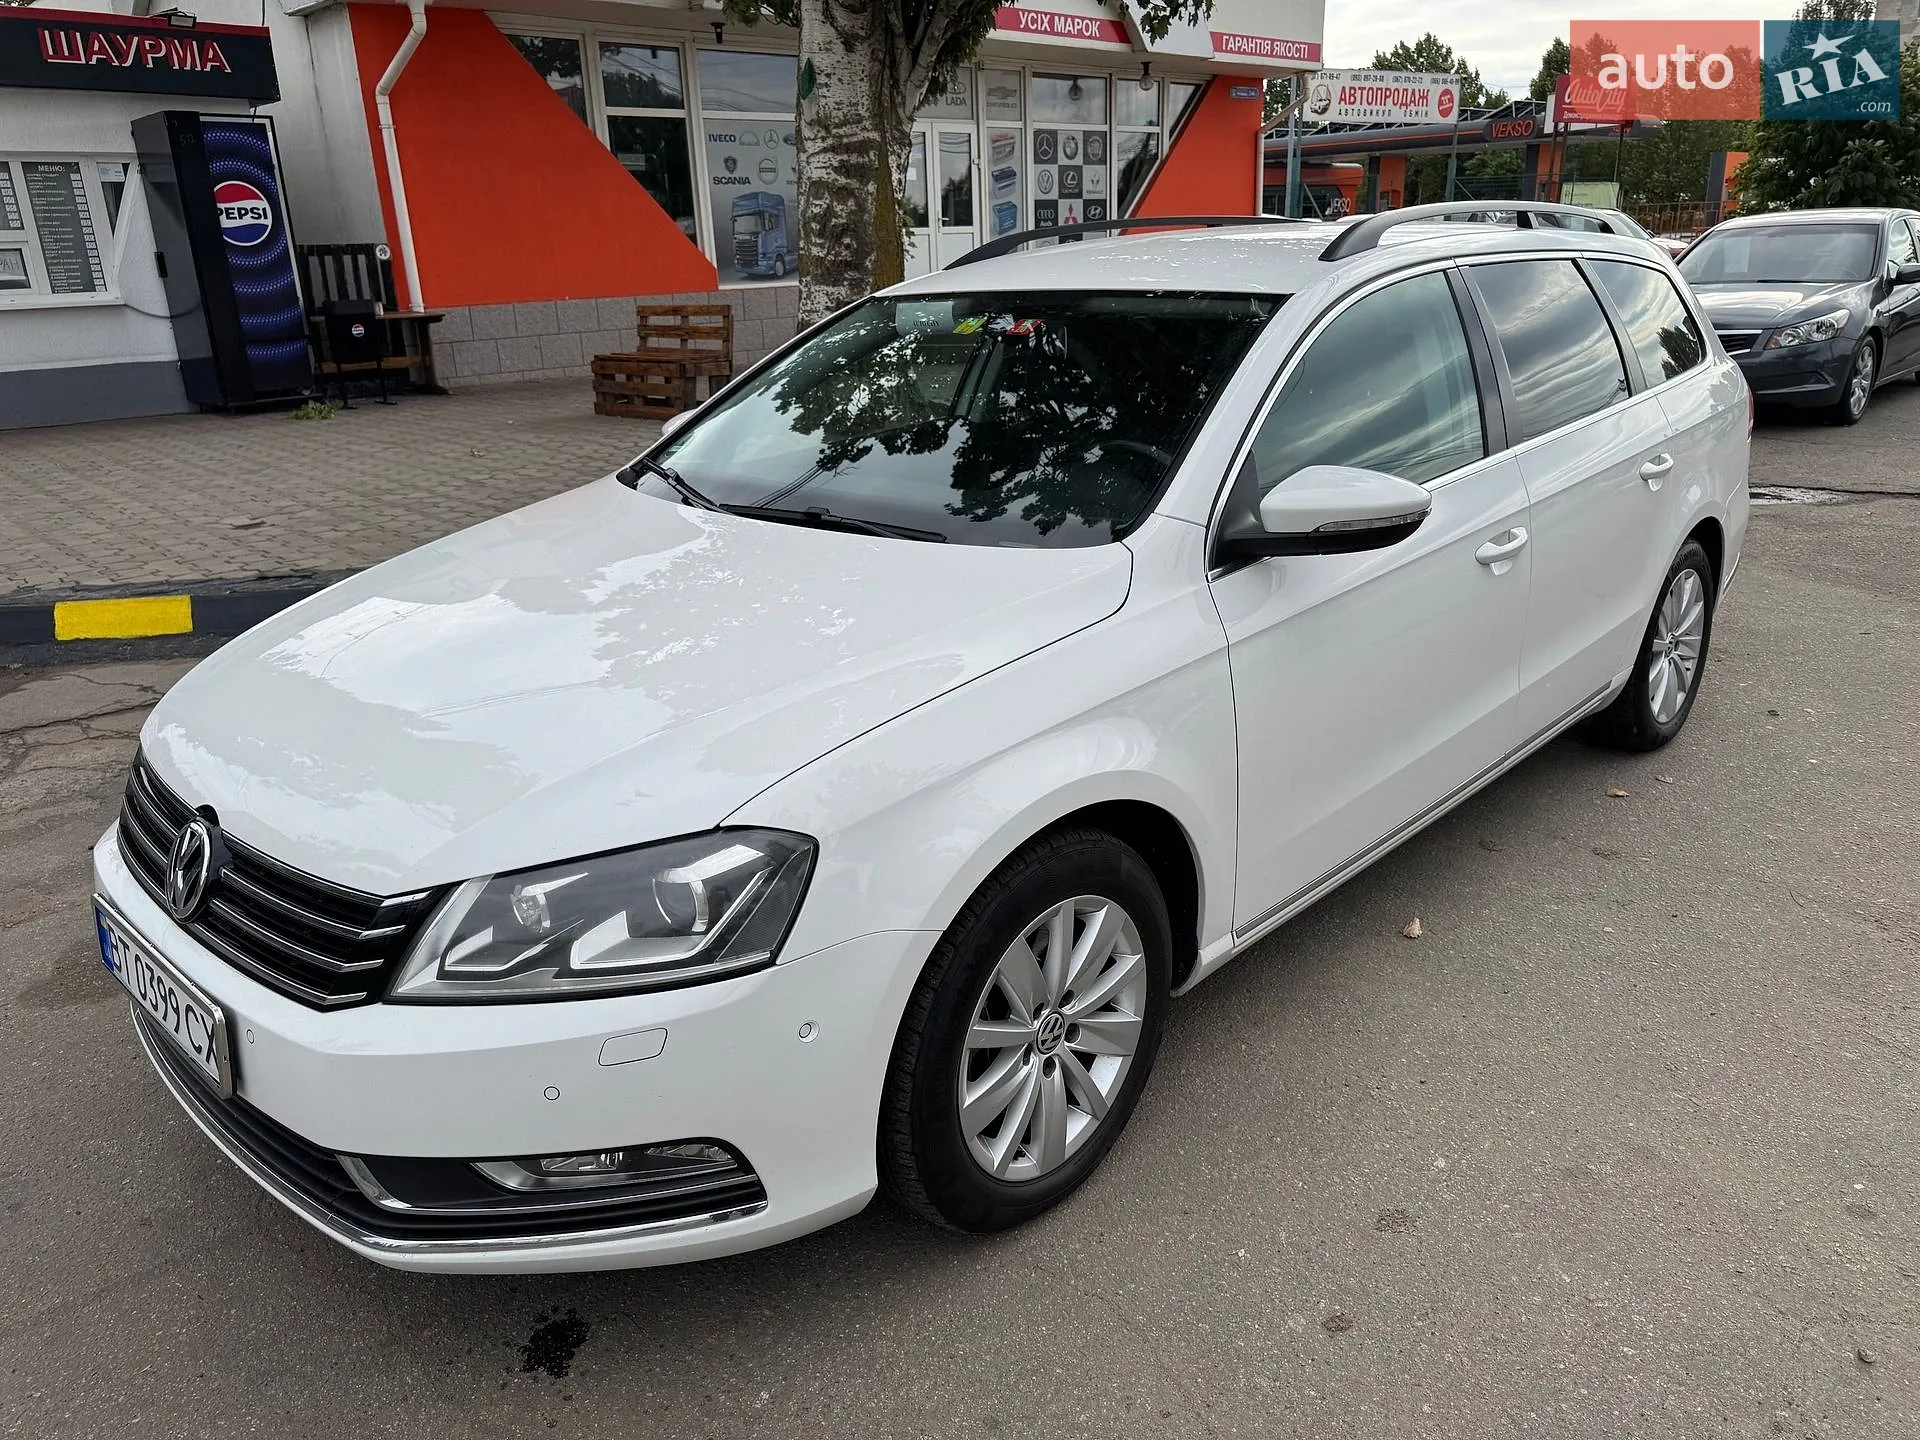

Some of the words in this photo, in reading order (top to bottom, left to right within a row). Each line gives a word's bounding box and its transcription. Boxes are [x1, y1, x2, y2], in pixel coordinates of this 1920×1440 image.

[1019, 11, 1050, 32] УСІХ
[1053, 15, 1100, 37] МАРОК
[37, 27, 232, 73] ШАУРМА
[1222, 35, 1270, 55] ГАРАНТІЯ
[1273, 41, 1308, 59] ЯКОСТІ
[945, 96, 967, 107] LADA
[1338, 85, 1430, 110] АВТОПРОДАЖ
[708, 133, 737, 143] IVECO
[1492, 119, 1534, 138] VEKSO
[713, 176, 752, 185] SCANIA
[217, 206, 268, 220] PEPSI
[107, 923, 131, 986] BT
[134, 953, 181, 1034] 0399
[184, 1003, 219, 1068] CX
